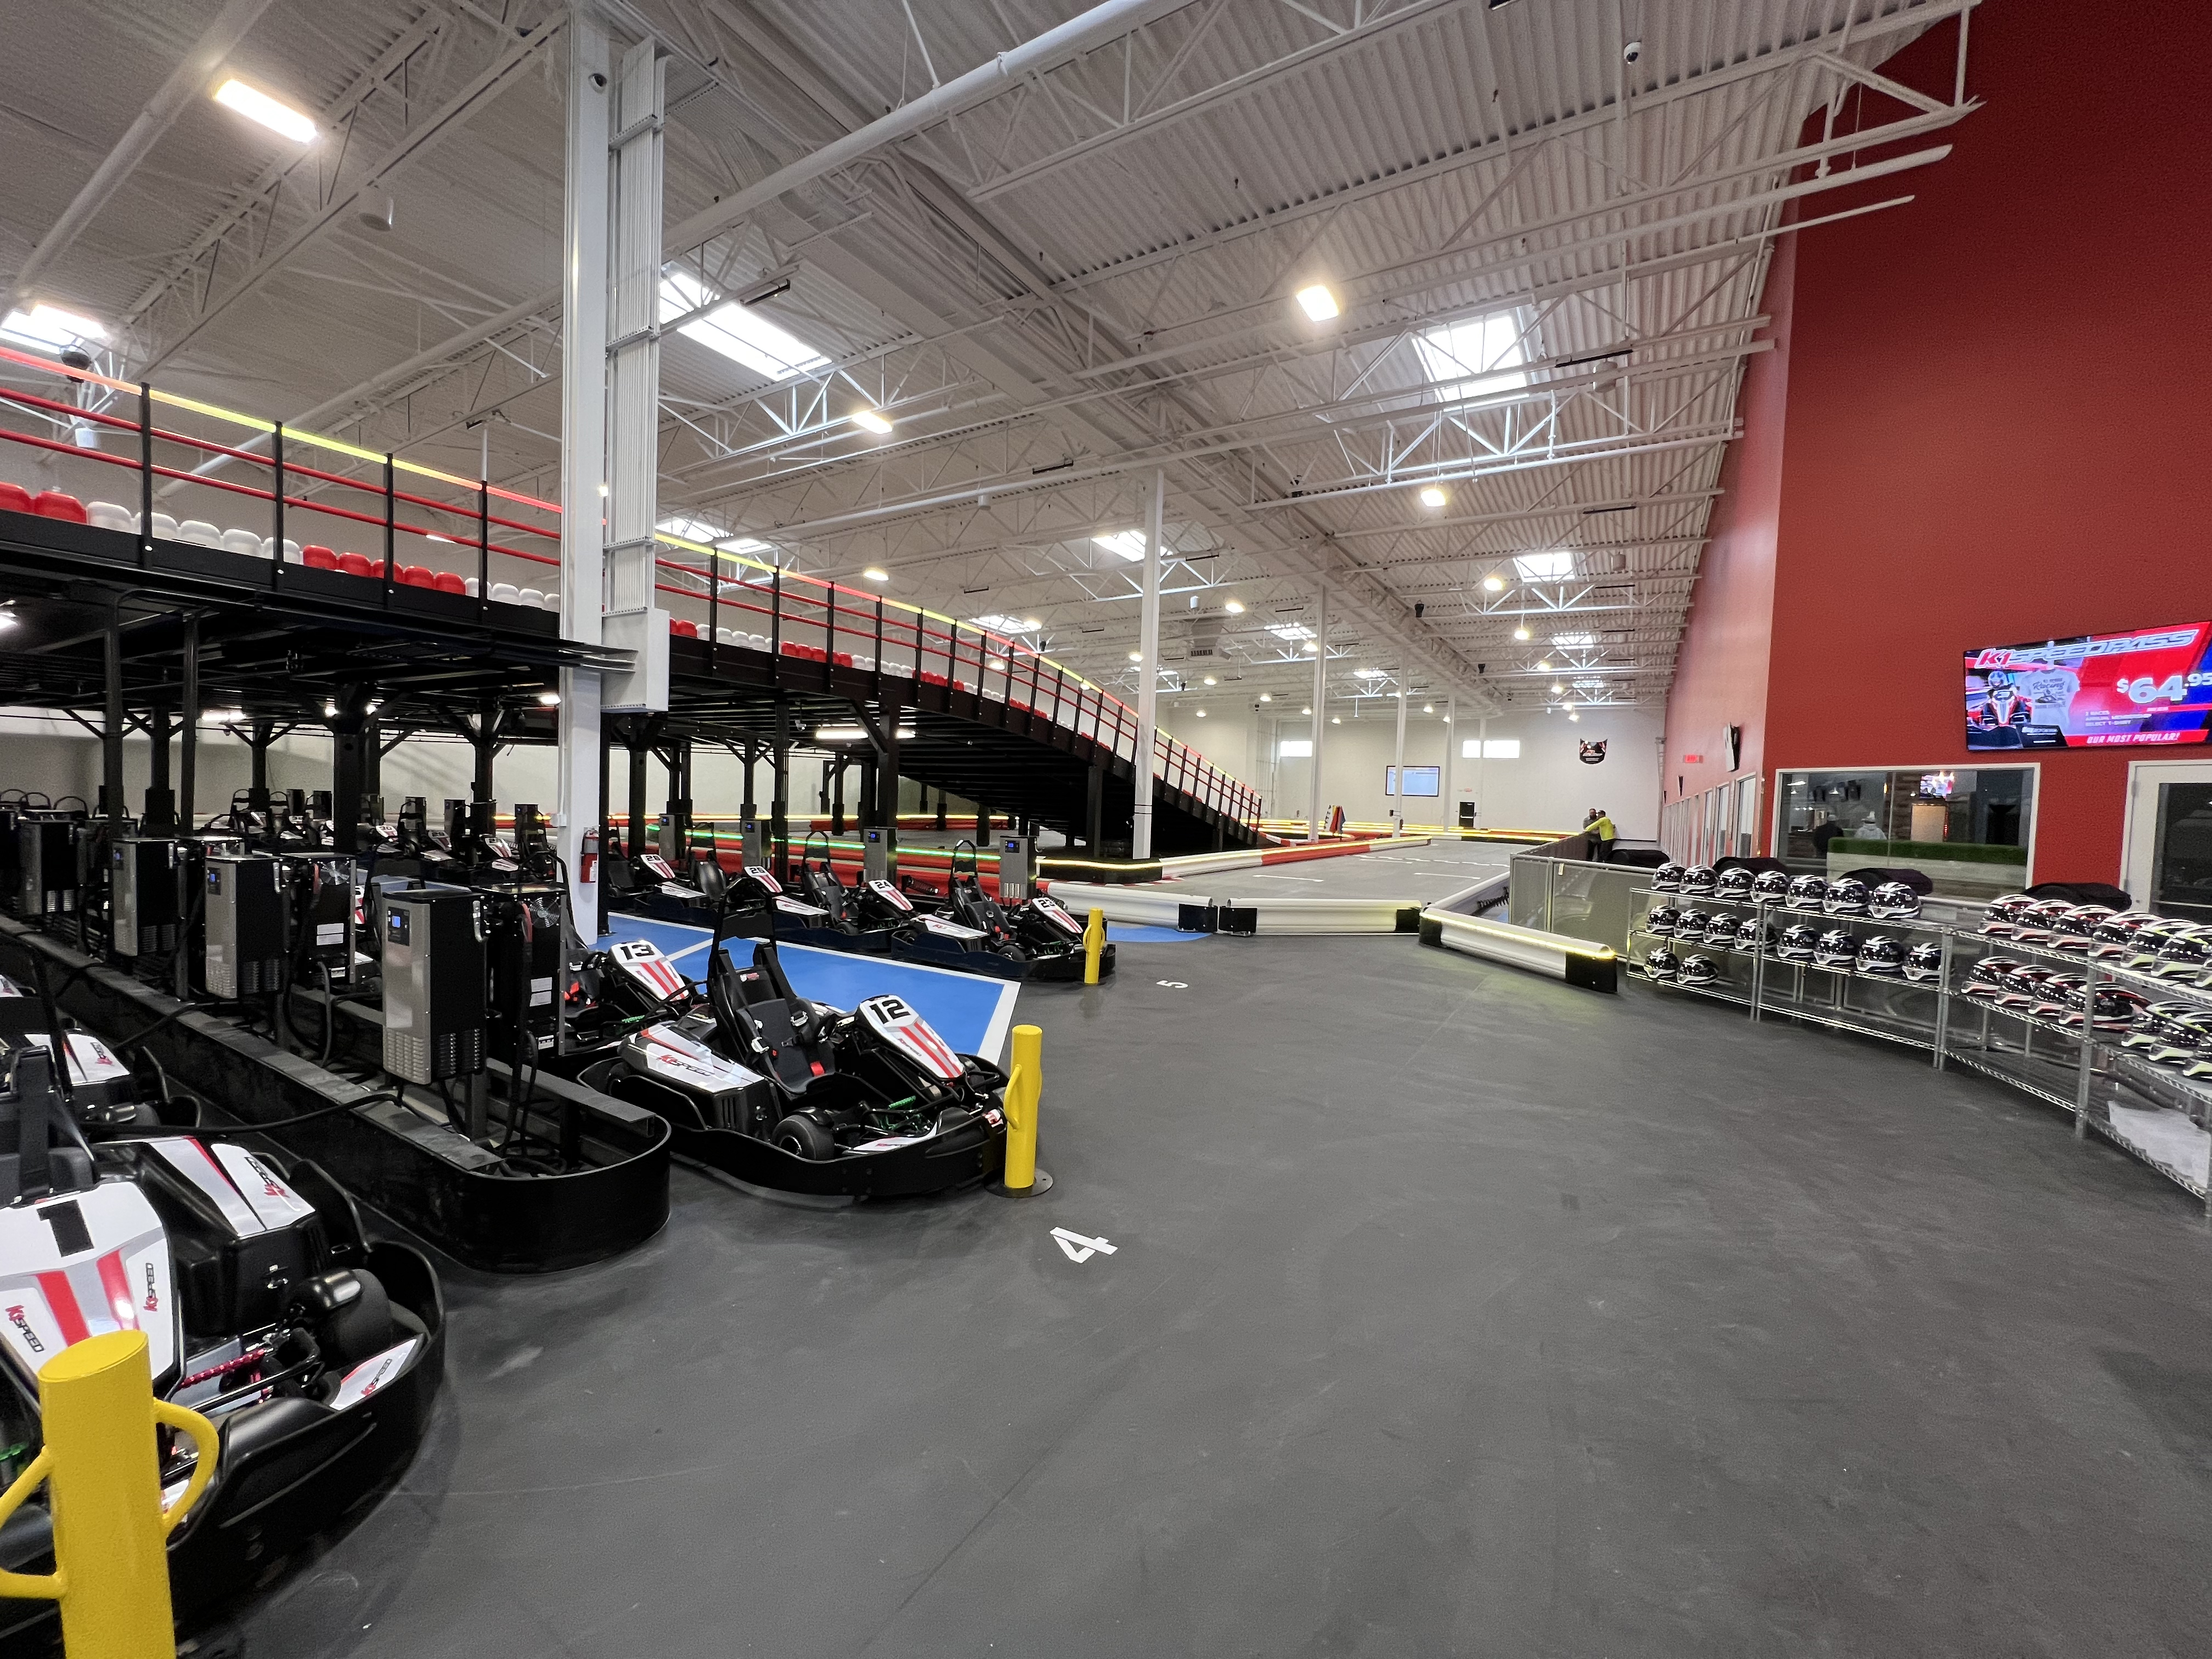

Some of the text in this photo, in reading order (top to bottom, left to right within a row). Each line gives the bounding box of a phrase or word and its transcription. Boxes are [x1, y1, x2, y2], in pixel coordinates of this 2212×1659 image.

[2107, 735, 2131, 743] MOST
[2132, 732, 2181, 742] POPULAR!
[1037, 899, 1056, 908] 23
[620, 944, 656, 961] 13
[1156, 979, 1188, 989] 5
[869, 999, 911, 1024] 12
[36, 1199, 94, 1257] 1
[1050, 1226, 1118, 1263] 4
